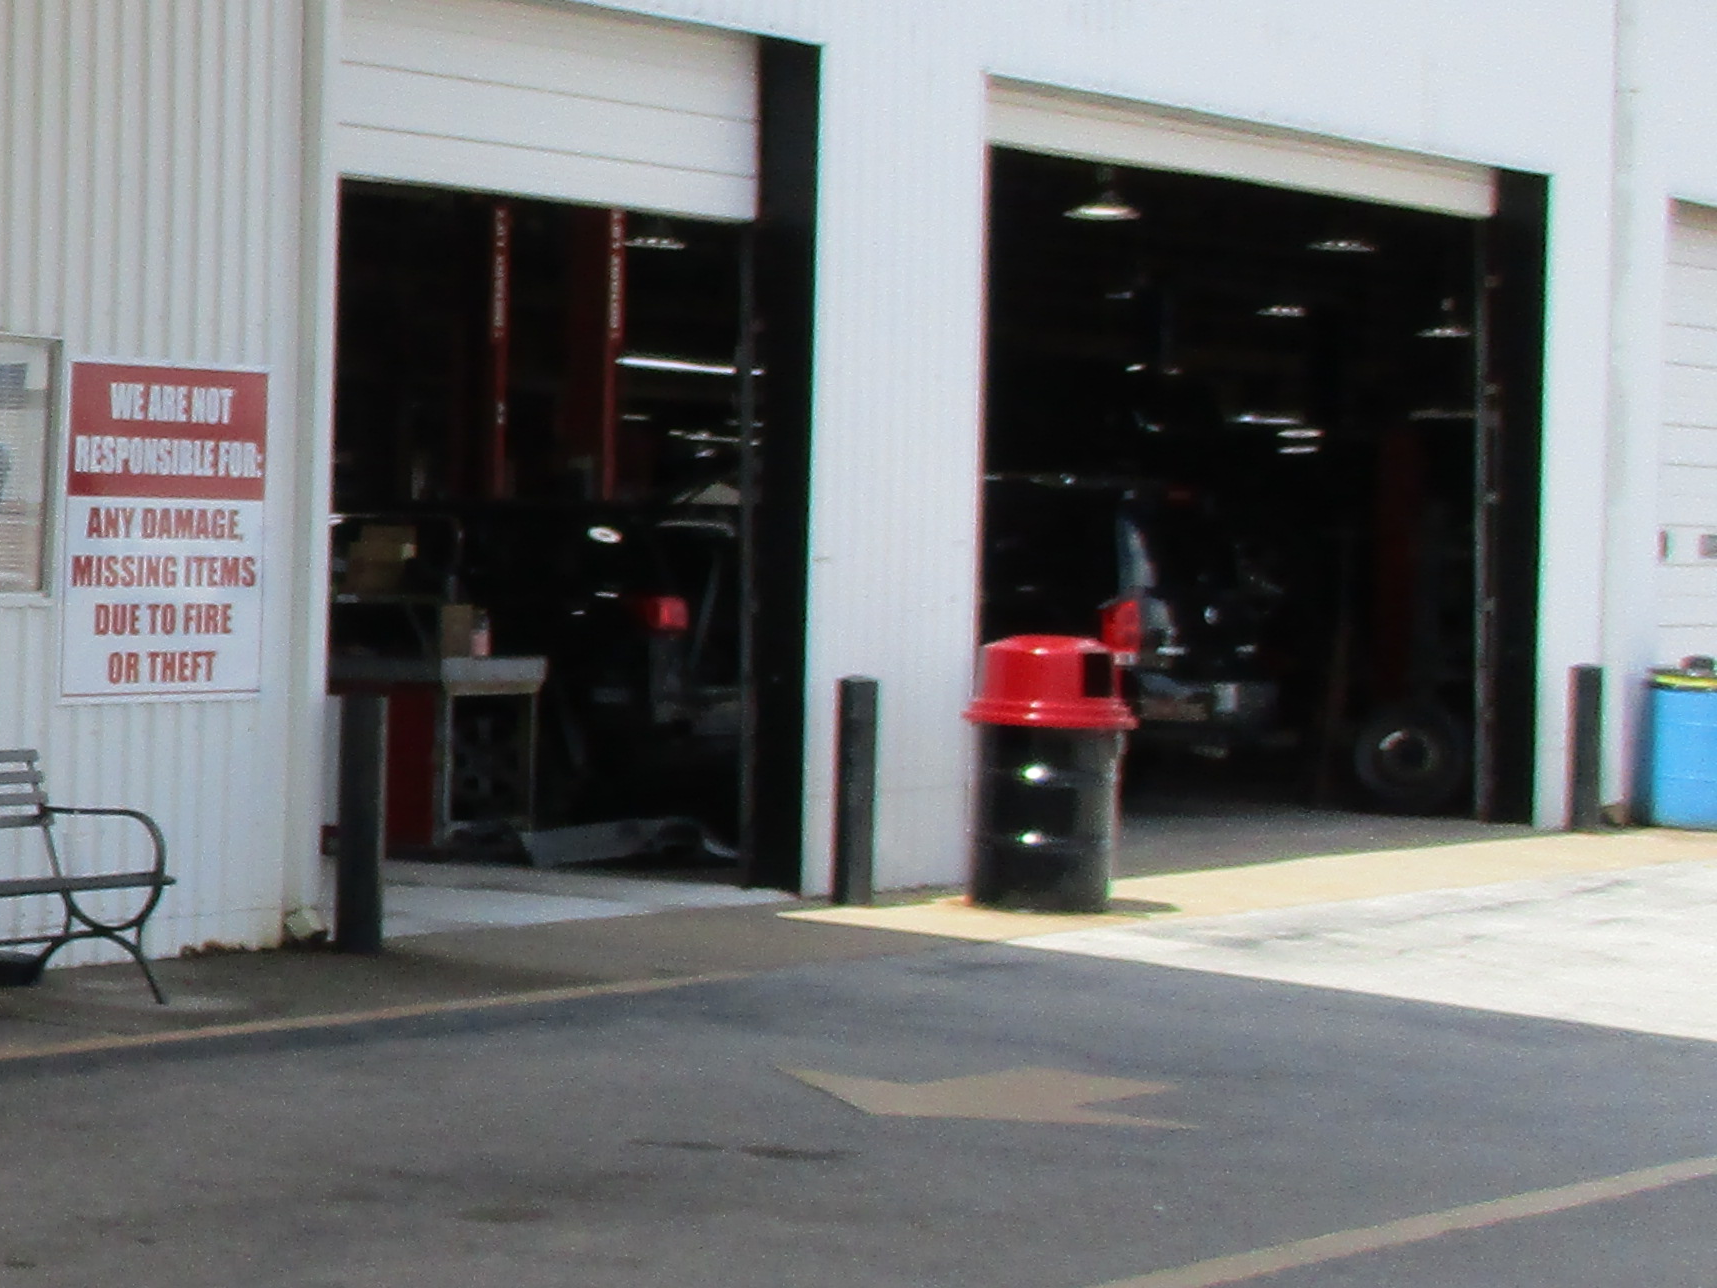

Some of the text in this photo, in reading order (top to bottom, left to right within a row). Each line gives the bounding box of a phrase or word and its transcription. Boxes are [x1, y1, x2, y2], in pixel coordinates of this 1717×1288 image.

[110, 382, 237, 425] WE ARE NOT
[74, 435, 264, 478] RESPONSIBLE FOR:
[86, 507, 135, 539] ANY
[71, 555, 256, 588] MISSING ITEMS
[94, 603, 233, 636] DUE TO FIRE
[107, 650, 217, 684] OR THEFT
